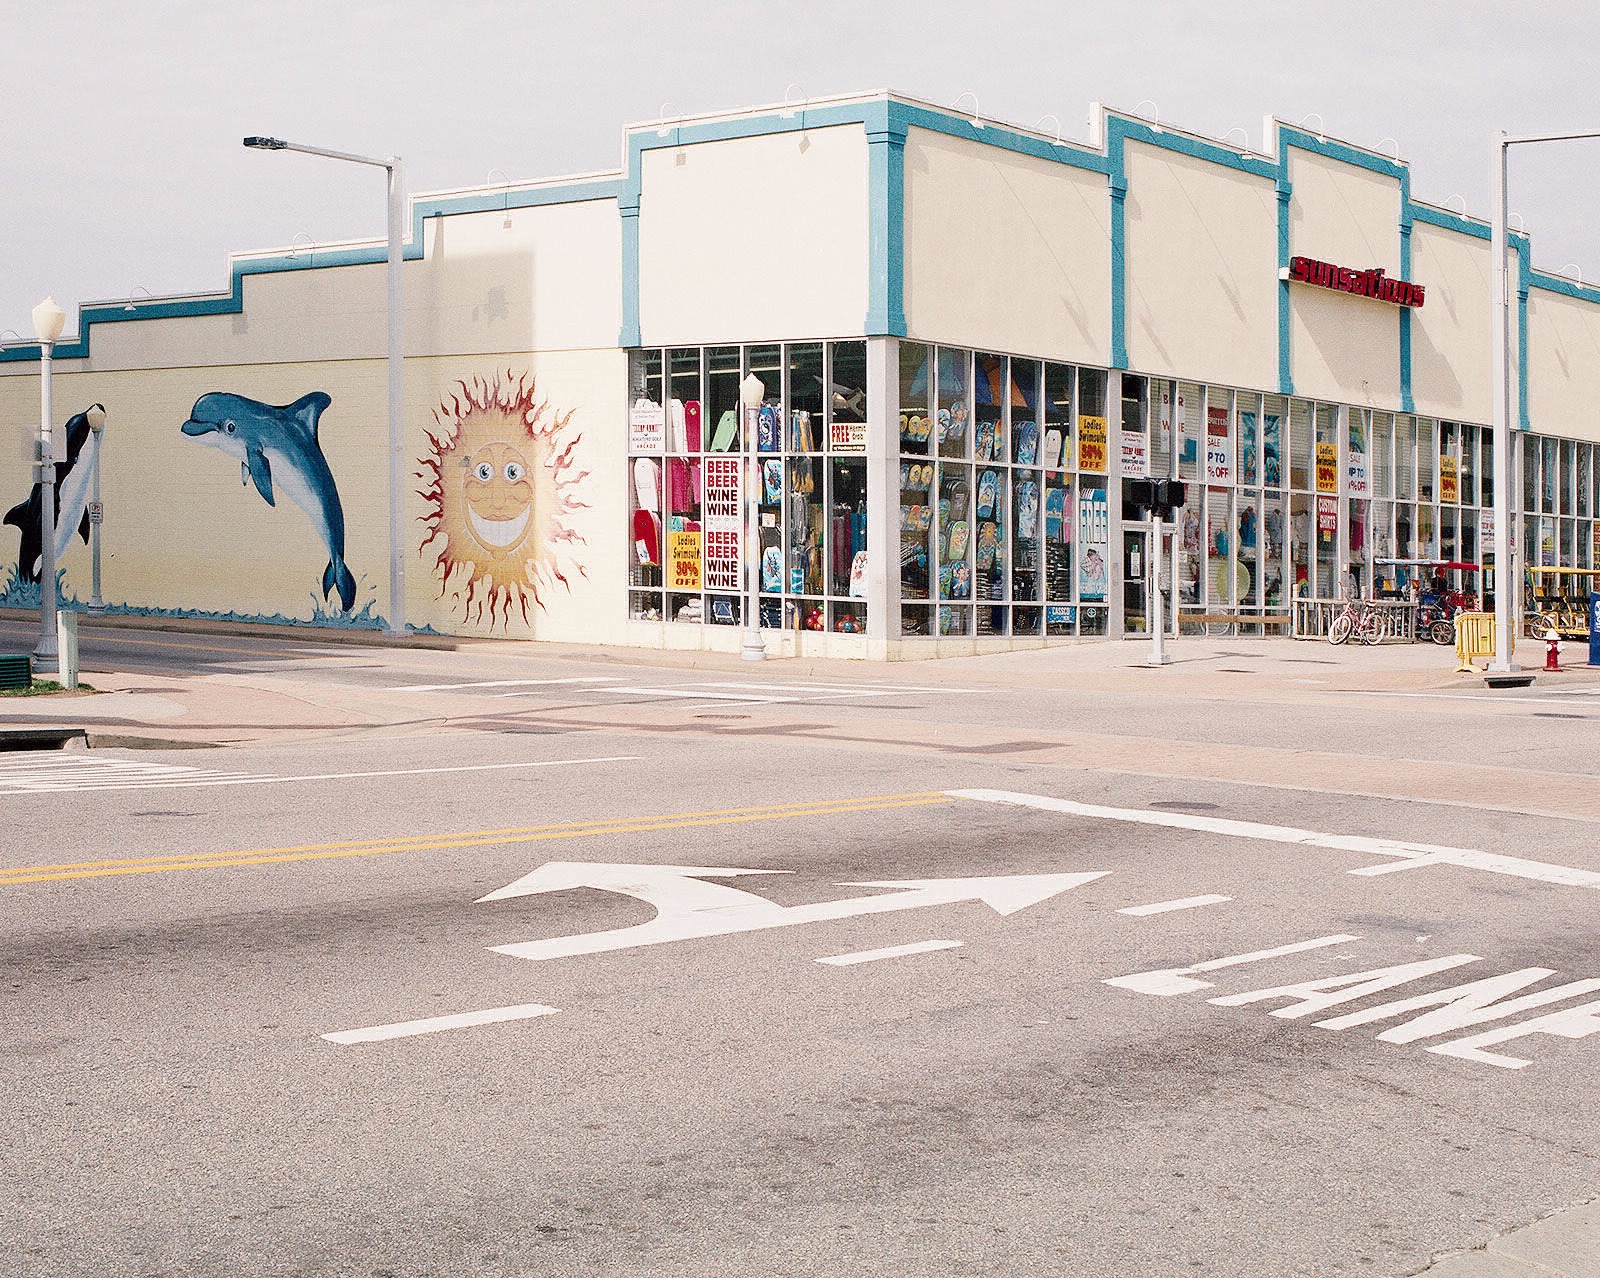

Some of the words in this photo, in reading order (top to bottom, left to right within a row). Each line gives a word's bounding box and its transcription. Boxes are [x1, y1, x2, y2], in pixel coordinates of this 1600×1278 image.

[1289, 256, 1425, 307] sunsations
[1163, 394, 1184, 407] BR
[1084, 419, 1101, 430] Ladies
[1162, 420, 1185, 433] WE
[832, 425, 849, 443] FREE
[1079, 430, 1106, 443] Swimsuits
[1208, 438, 1221, 448] SALE
[1082, 444, 1102, 460] 50%
[1208, 452, 1214, 462] P
[1215, 453, 1226, 464] TO
[707, 461, 738, 473] BEER
[1080, 460, 1101, 468] OFF
[1216, 467, 1229, 478] OFF
[707, 475, 738, 487] BEER
[707, 489, 738, 501] WINE
[707, 503, 738, 516] WINE
[1080, 501, 1107, 544] FREE
[1319, 513, 1336, 529] SHIRTS
[677, 535, 695, 545] Ladies
[707, 532, 738, 545] BEER
[707, 546, 738, 559] BEER
[676, 561, 698, 576] 50%
[707, 560, 738, 573] WINE
[676, 578, 698, 586] OFF
[707, 574, 738, 587] WINE
[1101, 934, 1600, 1069] LANE
